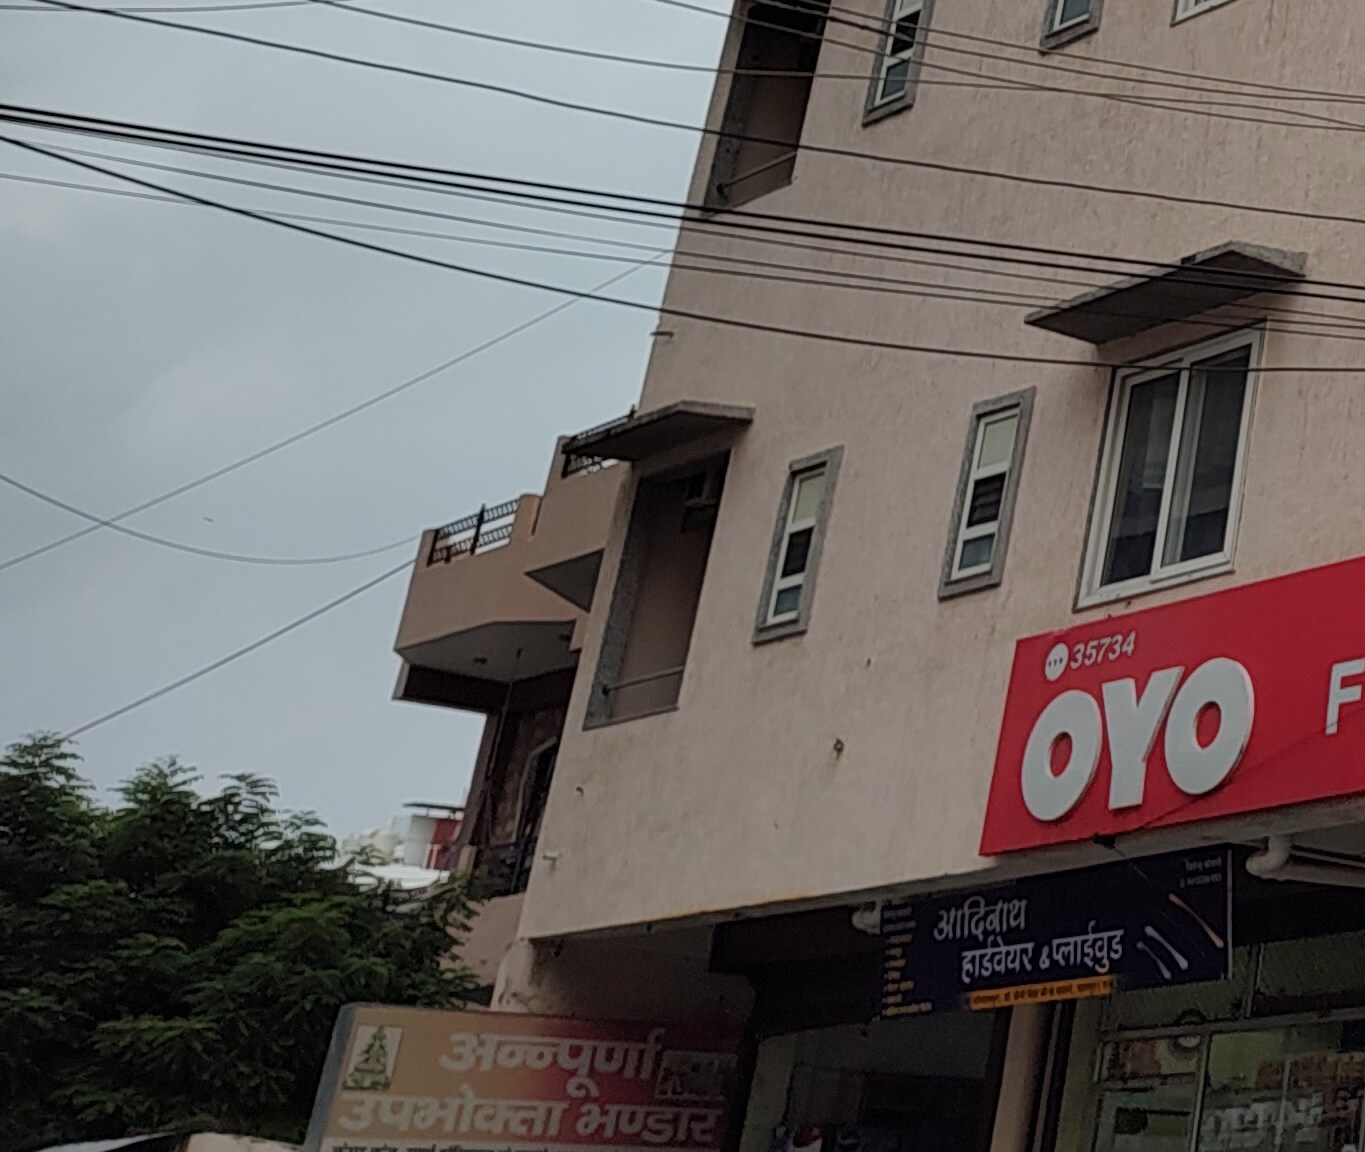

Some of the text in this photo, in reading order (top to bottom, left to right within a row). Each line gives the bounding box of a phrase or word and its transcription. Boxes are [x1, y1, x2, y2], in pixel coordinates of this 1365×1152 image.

[1069, 630, 1137, 671] 35734
[1021, 656, 1255, 821] OYO
[933, 895, 1028, 942] आदिनाथ
[960, 935, 1035, 984] हार्डवेयर
[337, 1084, 725, 1146] उपभोक्ता भण्डार
